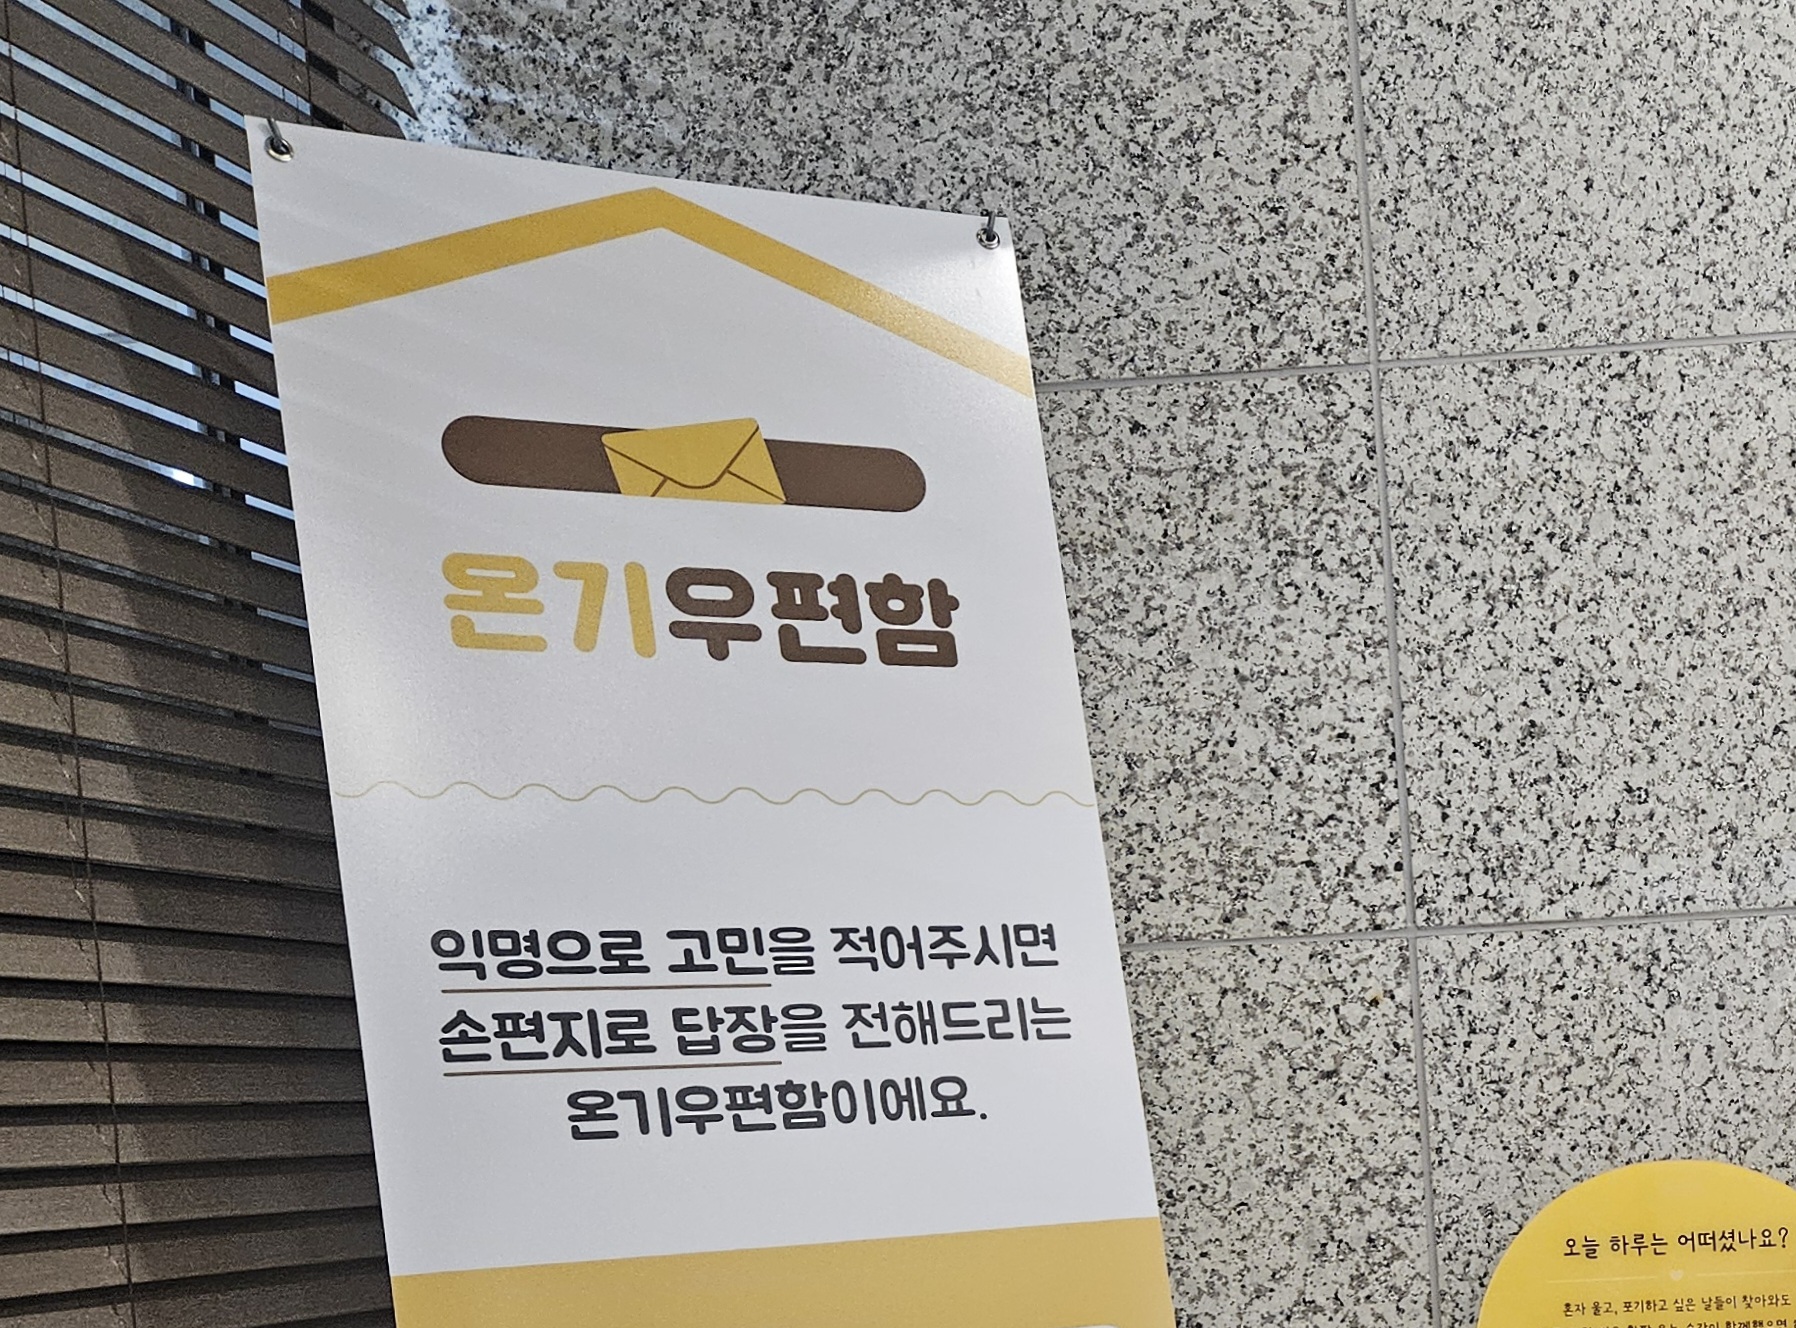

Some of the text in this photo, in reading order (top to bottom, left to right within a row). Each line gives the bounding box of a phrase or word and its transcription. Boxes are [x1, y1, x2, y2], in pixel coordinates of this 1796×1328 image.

[440, 552, 960, 668] 온기우편함
[430, 923, 1059, 979] 익명으로 고민을 적어주시면
[440, 997, 1073, 1062] 손편지로 답장을 전해드리는
[568, 1076, 988, 1140] 온기우편함이에요.
[1563, 1226, 1789, 1259] 오늘 하루는 어떠셨나요?
[1563, 1293, 1792, 1317] 혼자 울고, 포기하고 싶은 날들이 찾아와도
